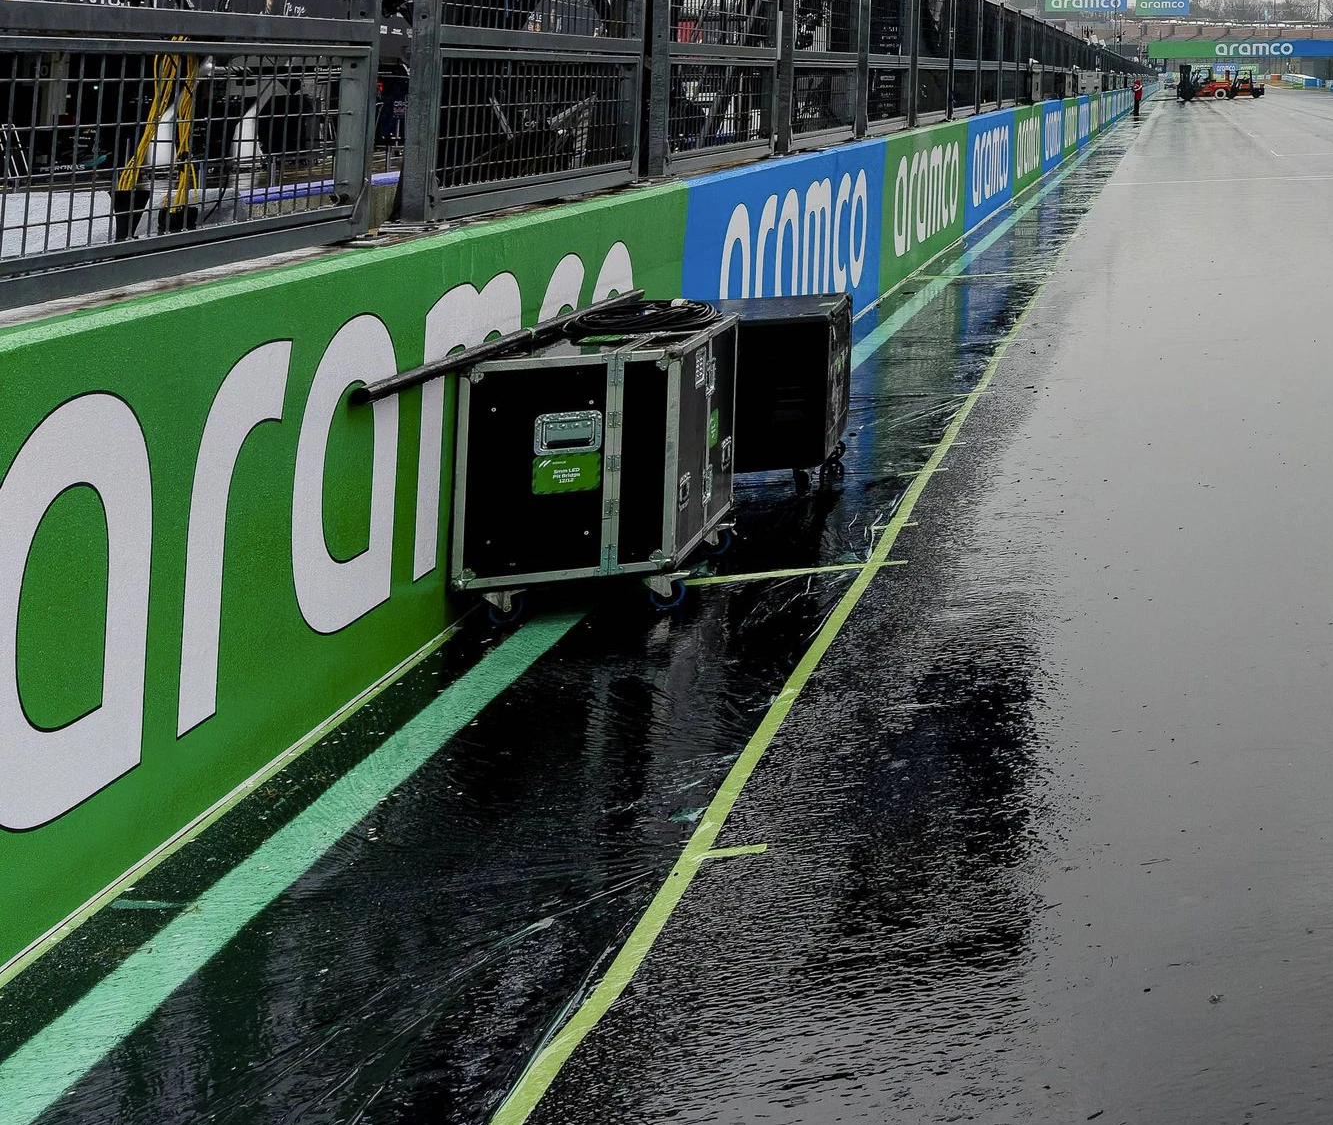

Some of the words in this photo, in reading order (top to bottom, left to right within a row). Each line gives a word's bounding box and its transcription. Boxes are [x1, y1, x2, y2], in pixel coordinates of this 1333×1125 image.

[1140, 0, 1185, 9] aramco
[1215, 42, 1294, 55] aramco
[893, 140, 960, 257] aramco
[971, 125, 1009, 207] aramco
[720, 169, 868, 299] aramco
